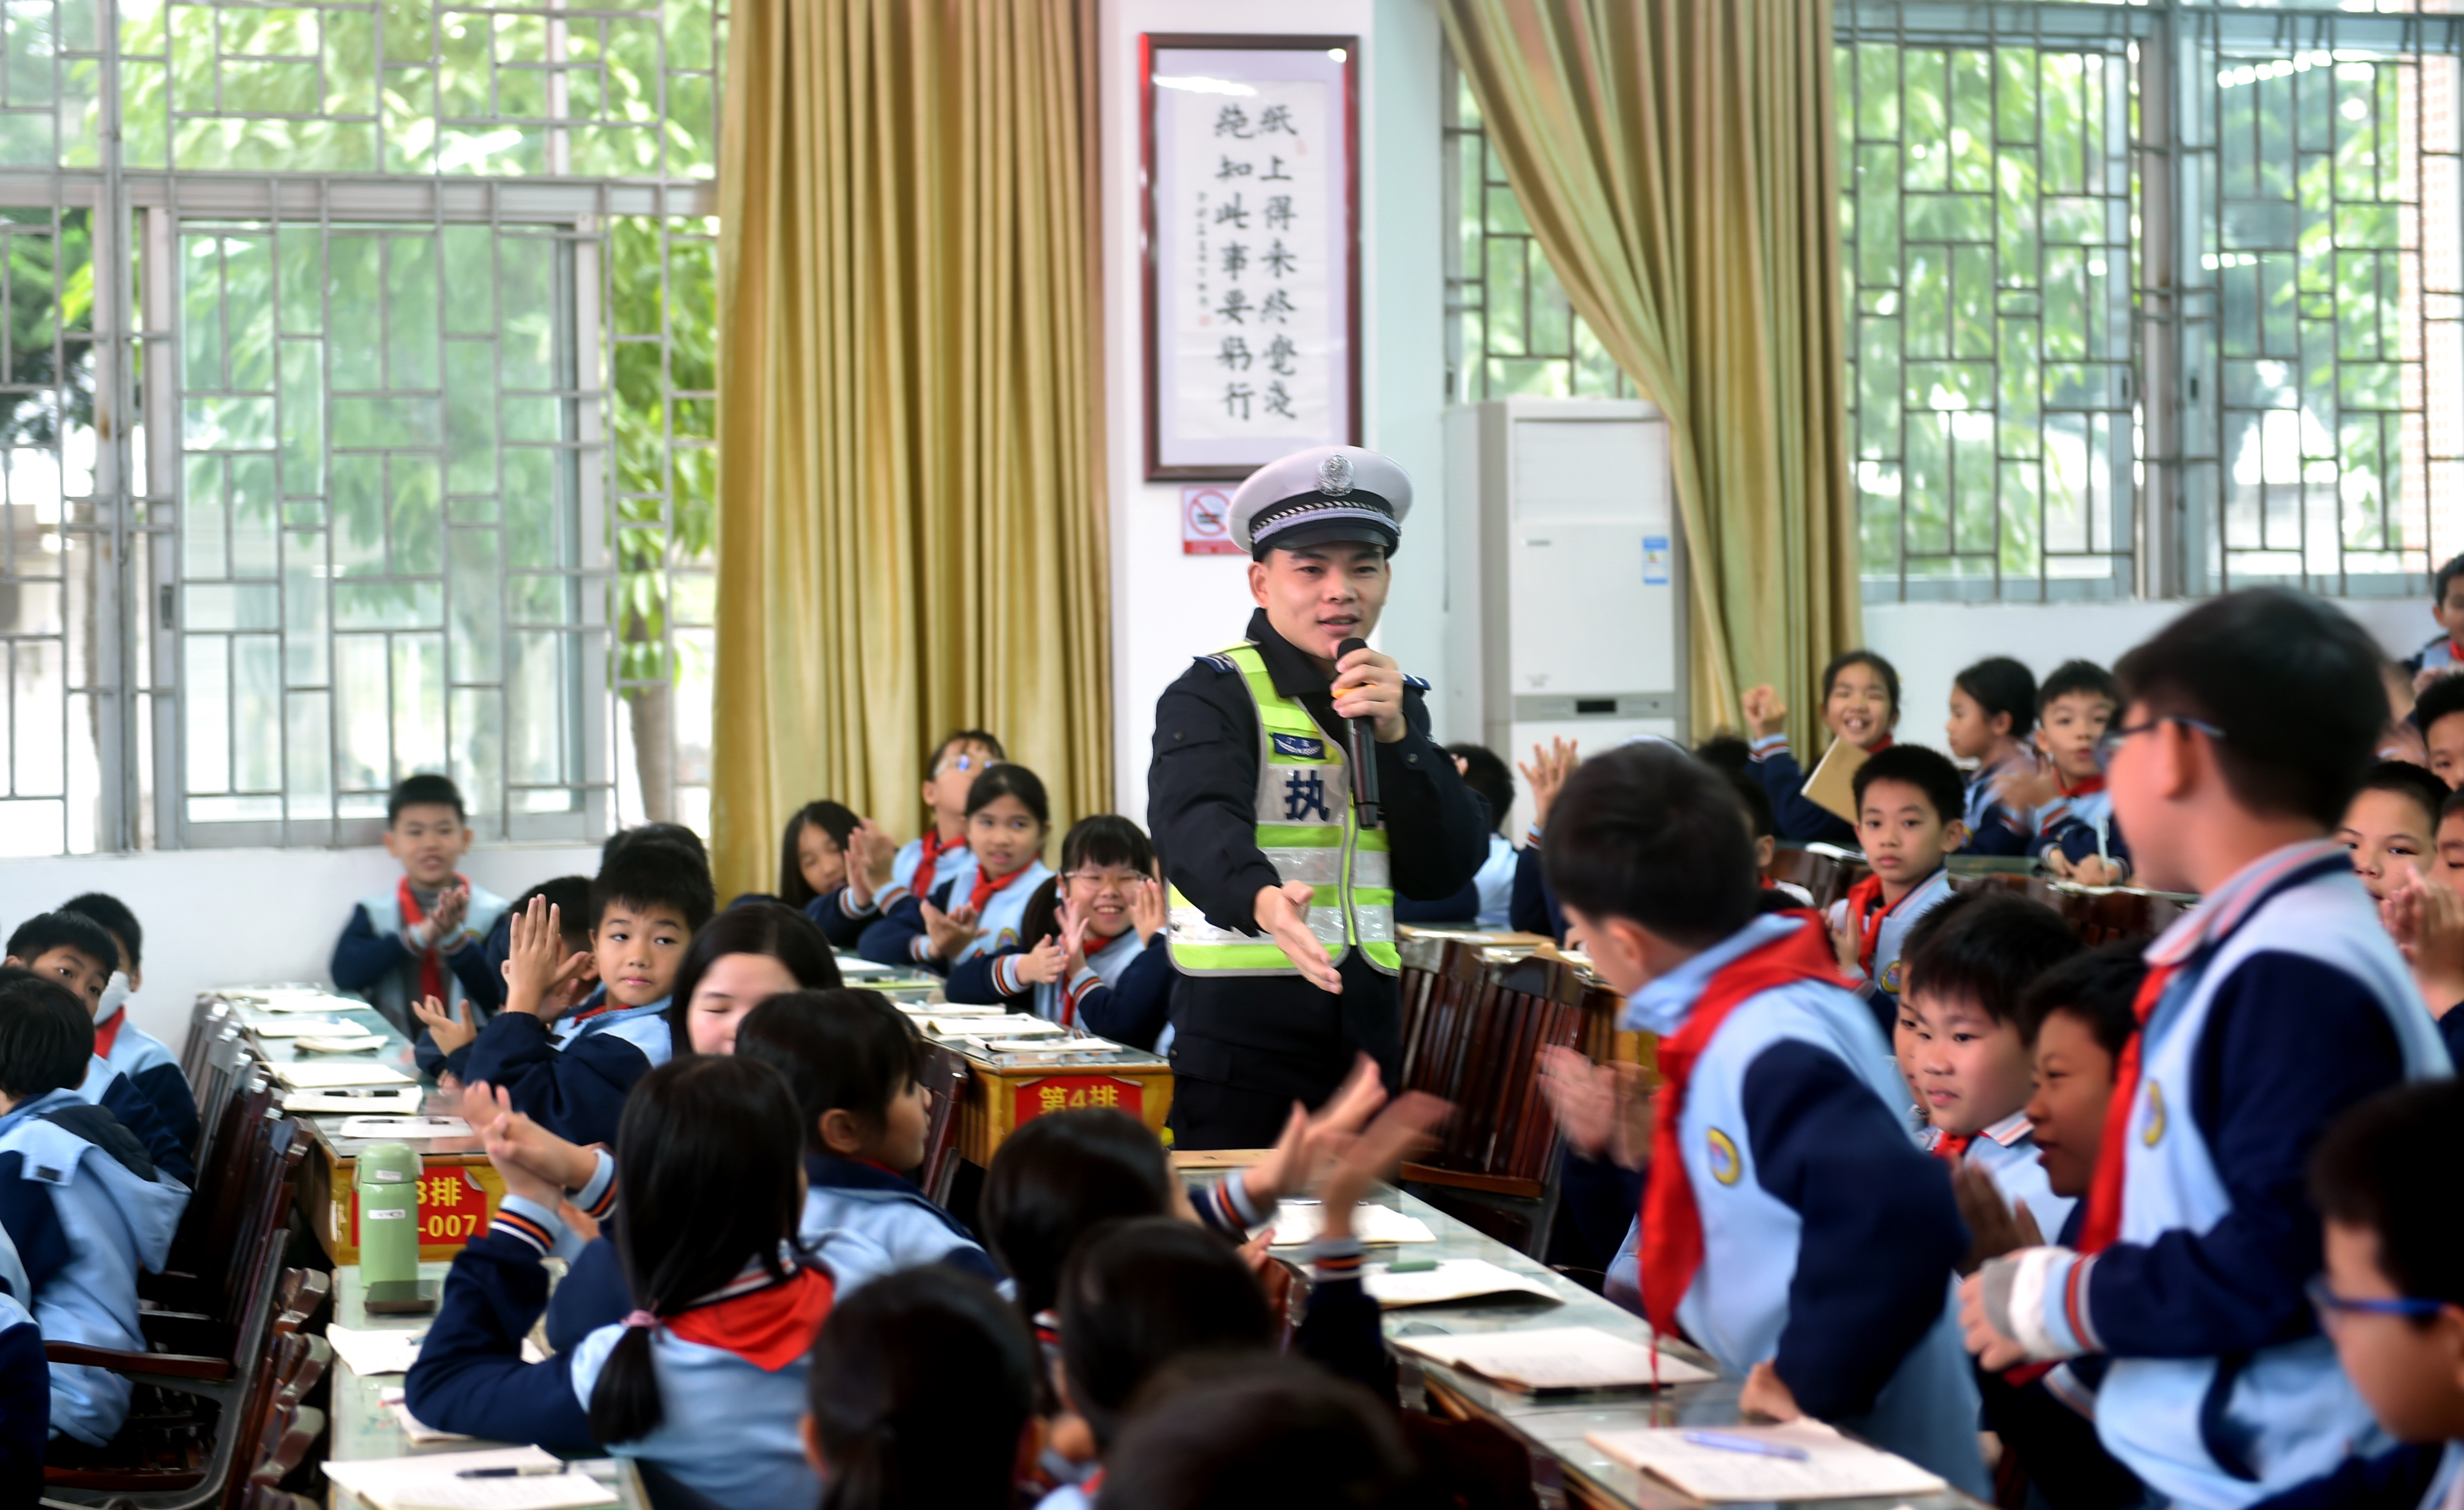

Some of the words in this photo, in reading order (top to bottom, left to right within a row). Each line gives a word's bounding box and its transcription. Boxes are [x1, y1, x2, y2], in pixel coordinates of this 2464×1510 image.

[1285, 769, 1331, 822] 执
[1038, 1085, 1119, 1114] 第4排
[416, 1177, 463, 1207] 3排
[417, 1214, 477, 1237] -007
